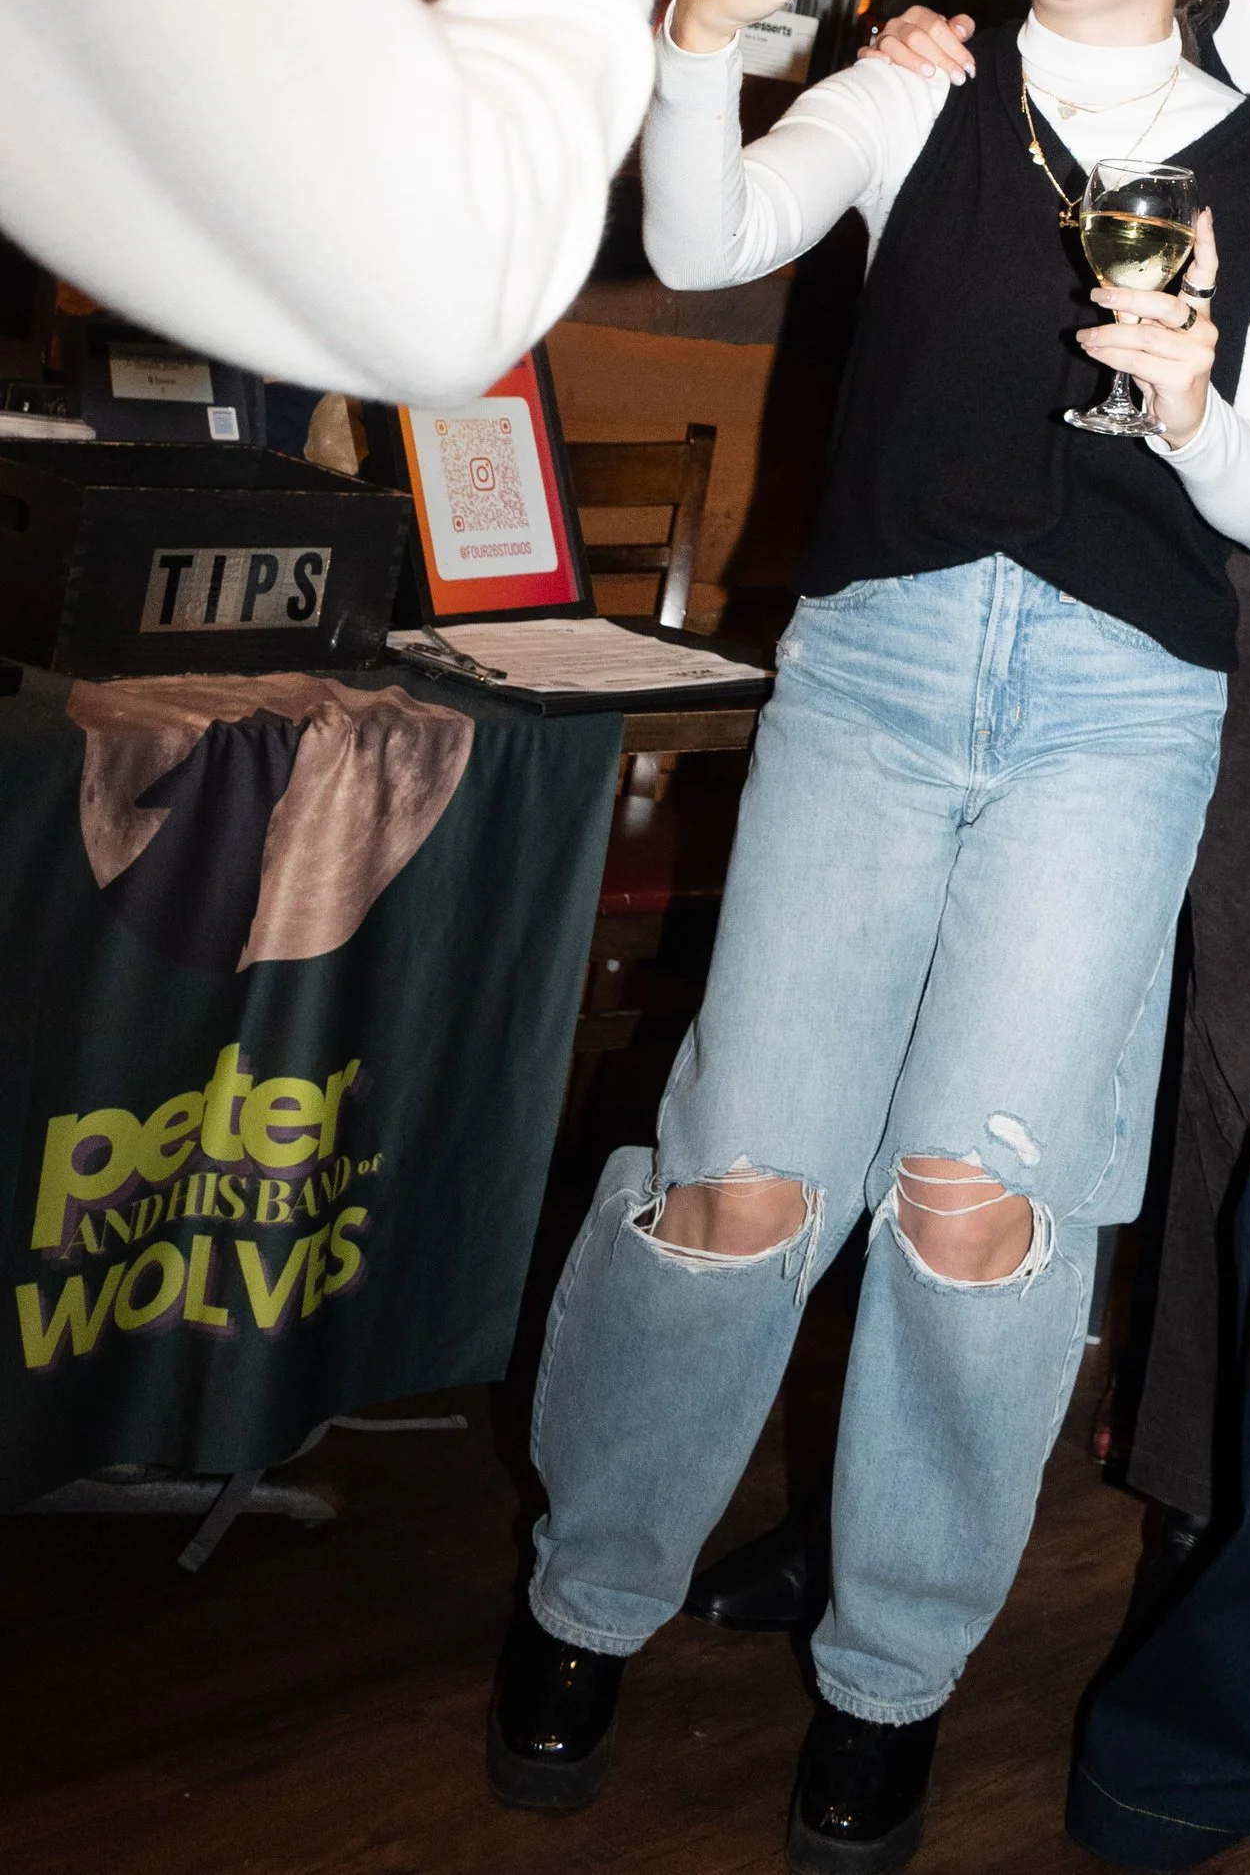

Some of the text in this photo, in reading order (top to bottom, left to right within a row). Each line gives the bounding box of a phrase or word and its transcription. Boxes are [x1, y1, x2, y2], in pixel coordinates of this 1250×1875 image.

[157, 551, 324, 625] TIPS
[460, 541, 532, 559] @FOUR26STUDIOS
[30, 1042, 364, 1251] peter
[59, 1152, 383, 1260] AND HIS BAND of
[14, 1205, 369, 1370] WOLVES
